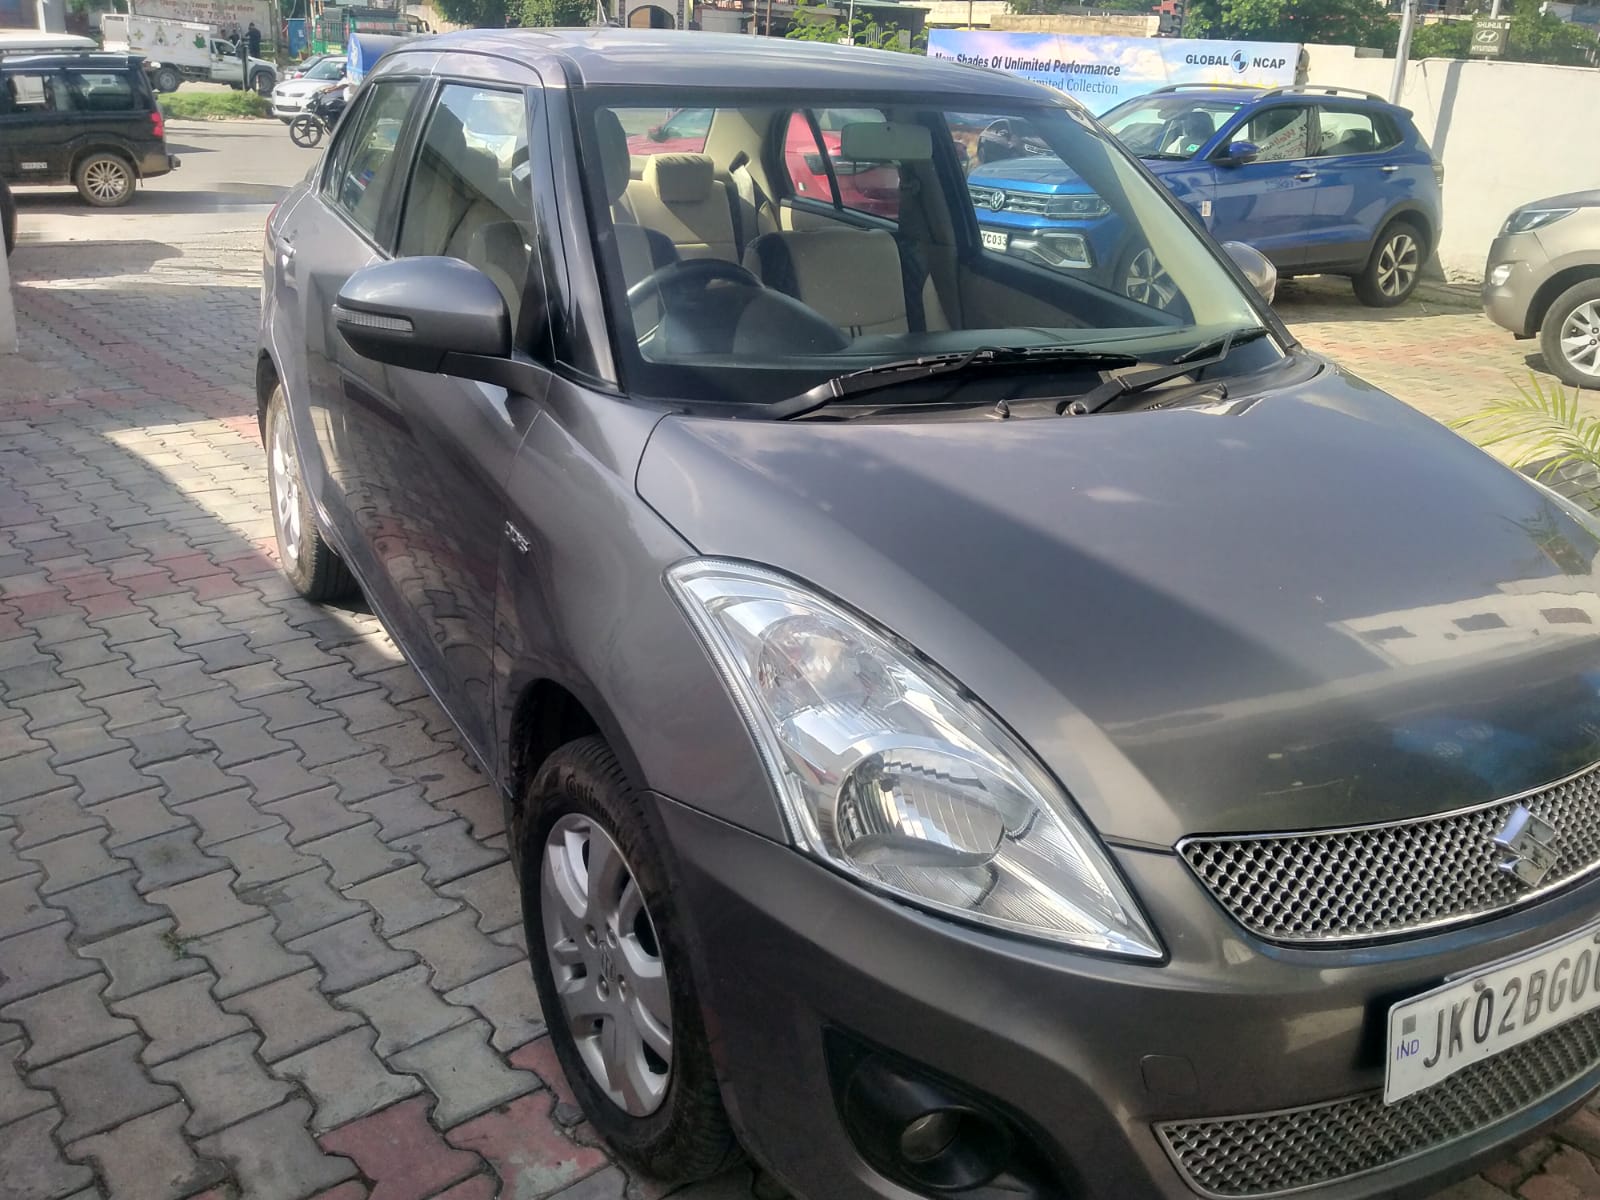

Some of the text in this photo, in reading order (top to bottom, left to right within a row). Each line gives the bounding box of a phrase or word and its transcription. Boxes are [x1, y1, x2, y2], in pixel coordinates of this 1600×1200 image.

[957, 53, 989, 68] Shades
[991, 55, 1002, 69] Of
[1004, 56, 1050, 72] Unlimited
[1053, 59, 1121, 77] Performance
[1185, 54, 1286, 69] GLOBAL NCAP
[1066, 78, 1118, 95] Collection
[1396, 1038, 1419, 1061] IND
